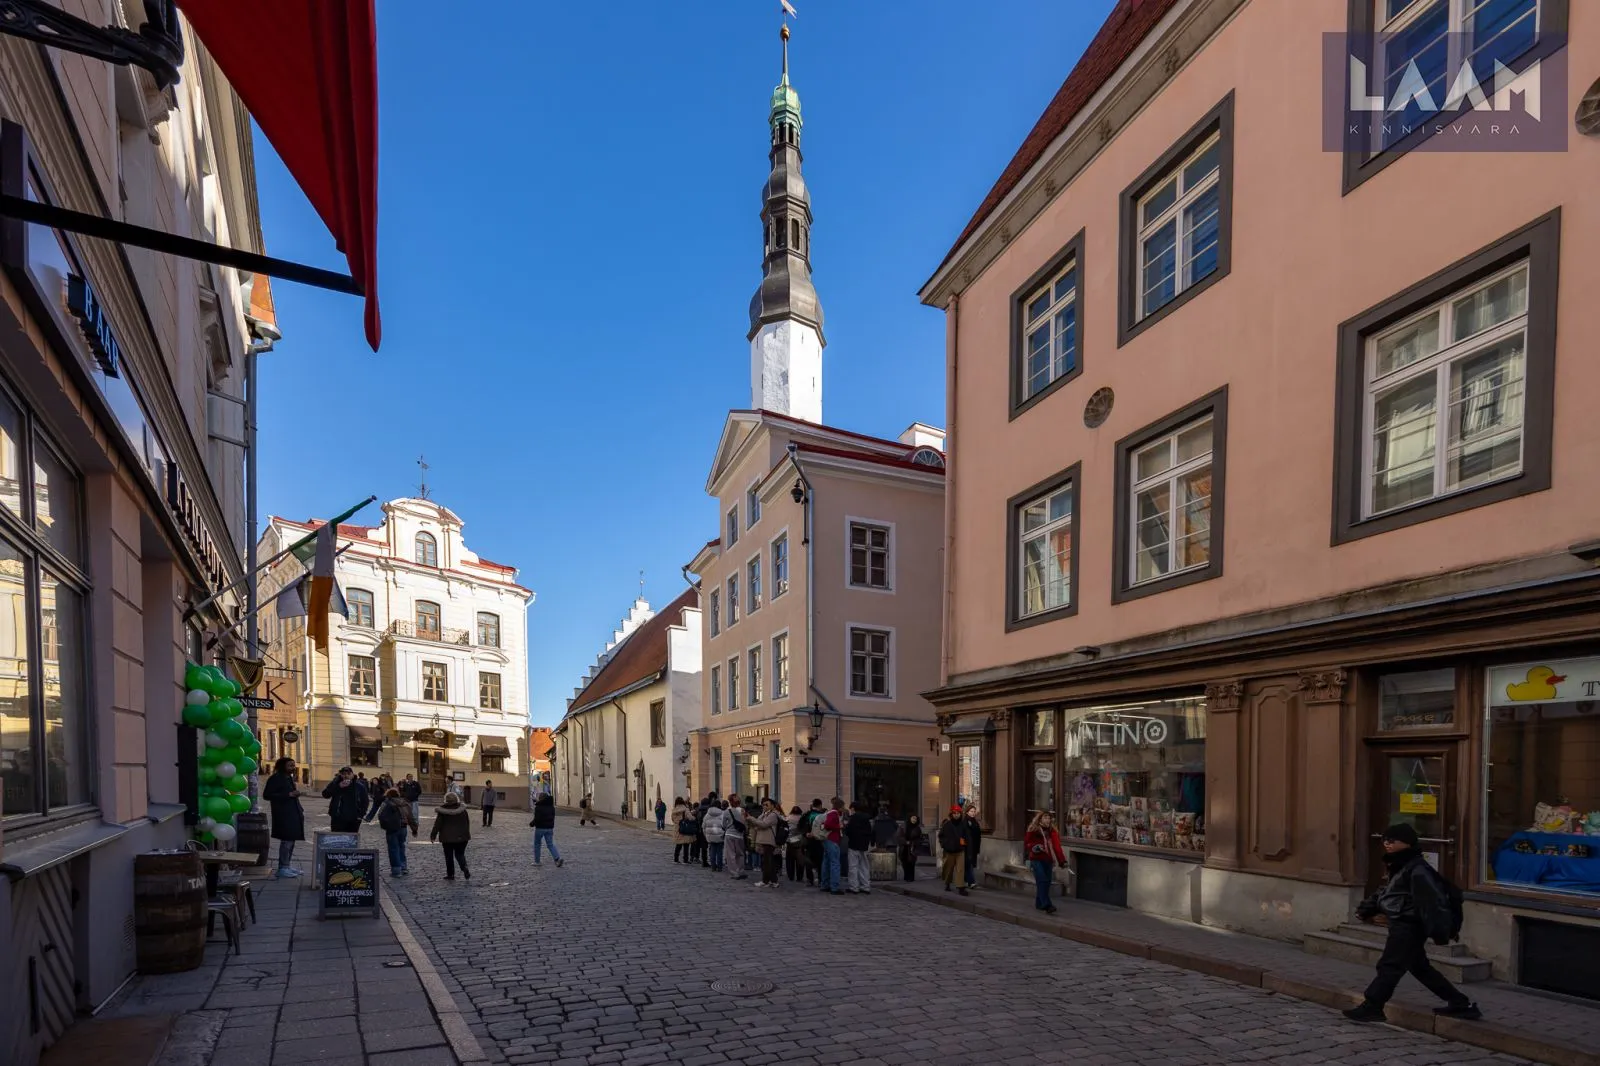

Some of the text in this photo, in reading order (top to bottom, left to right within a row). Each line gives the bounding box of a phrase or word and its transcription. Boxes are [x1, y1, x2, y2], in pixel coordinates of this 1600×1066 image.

[85, 279, 118, 371] BAAR
[264, 681, 291, 705] K
[241, 698, 272, 708] NNESS
[341, 896, 355, 905] PIE
